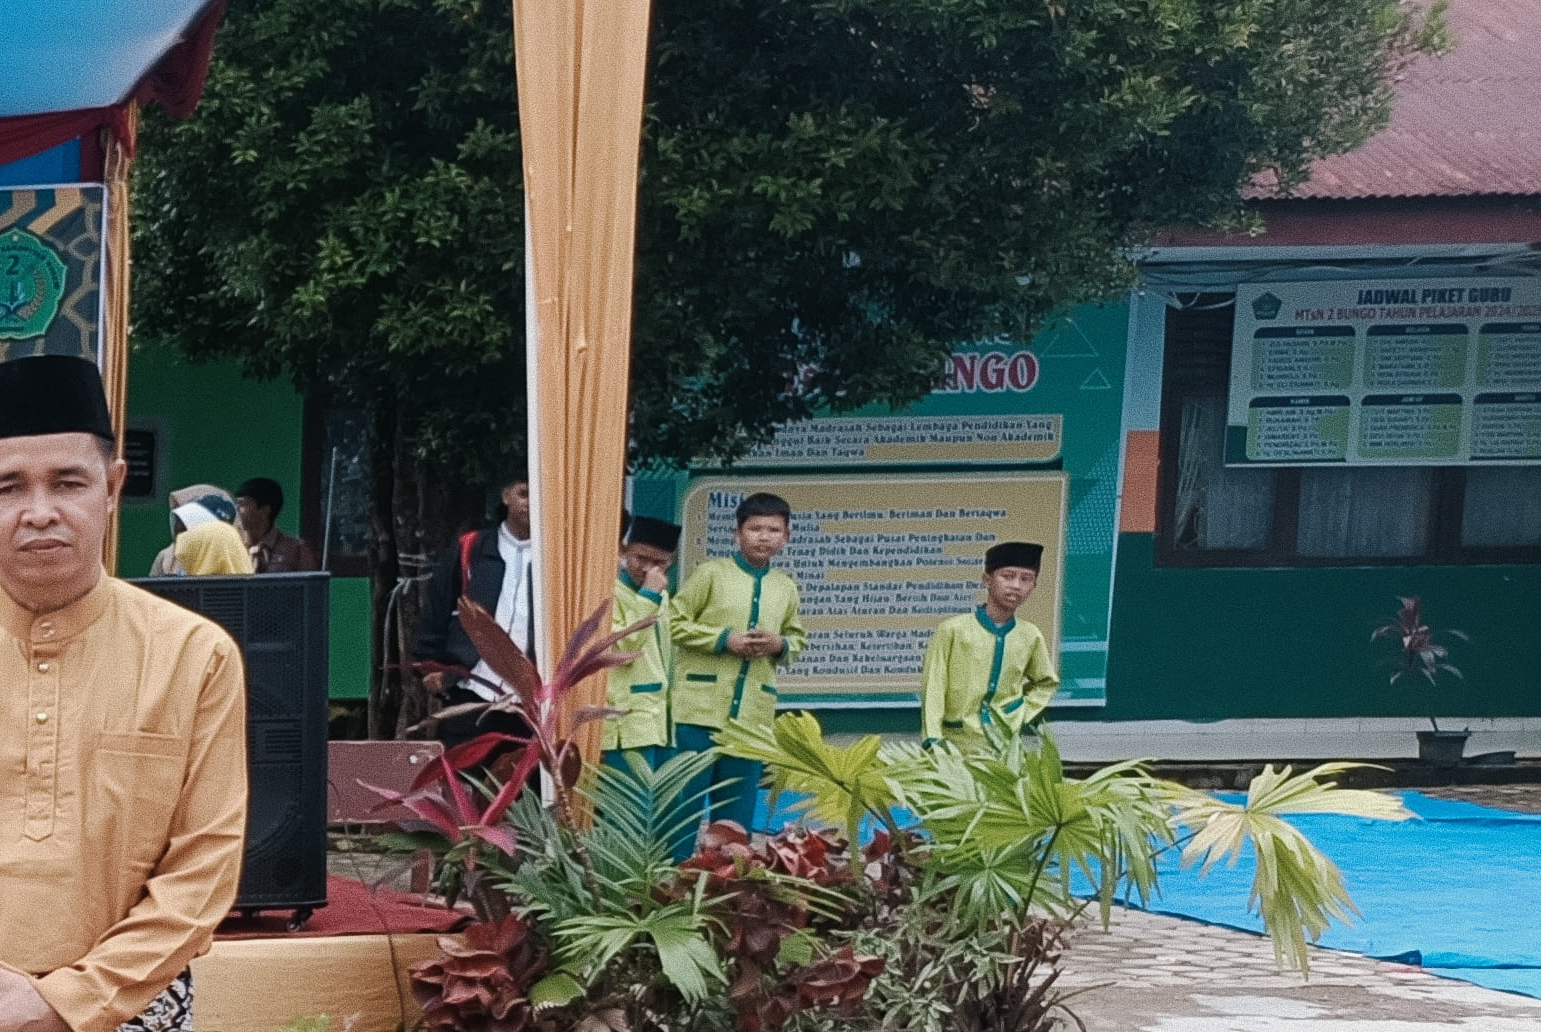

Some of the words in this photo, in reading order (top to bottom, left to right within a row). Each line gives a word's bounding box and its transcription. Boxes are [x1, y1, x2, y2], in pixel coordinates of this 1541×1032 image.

[5, 254, 20, 276] 2
[1356, 288, 1418, 305] JADWAL
[1420, 287, 1466, 304] PIKET
[1467, 286, 1513, 303] GURU
[1336, 307, 1376, 320] BUNGO
[1378, 306, 1417, 319] TAHUN
[1418, 305, 1482, 318] PELAJARAN
[930, 350, 1039, 394] NGO
[961, 420, 1023, 431] Pendidikan
[1025, 419, 1053, 431] Yang
[976, 431, 998, 442] Non
[1000, 430, 1054, 442] Akademik
[806, 447, 828, 457] Dan
[831, 446, 866, 458] Taqwa
[935, 507, 956, 519] Dan
[790, 534, 831, 545] adrasah
[848, 546, 870, 556] Dan
[871, 546, 943, 557] Kependidikan
